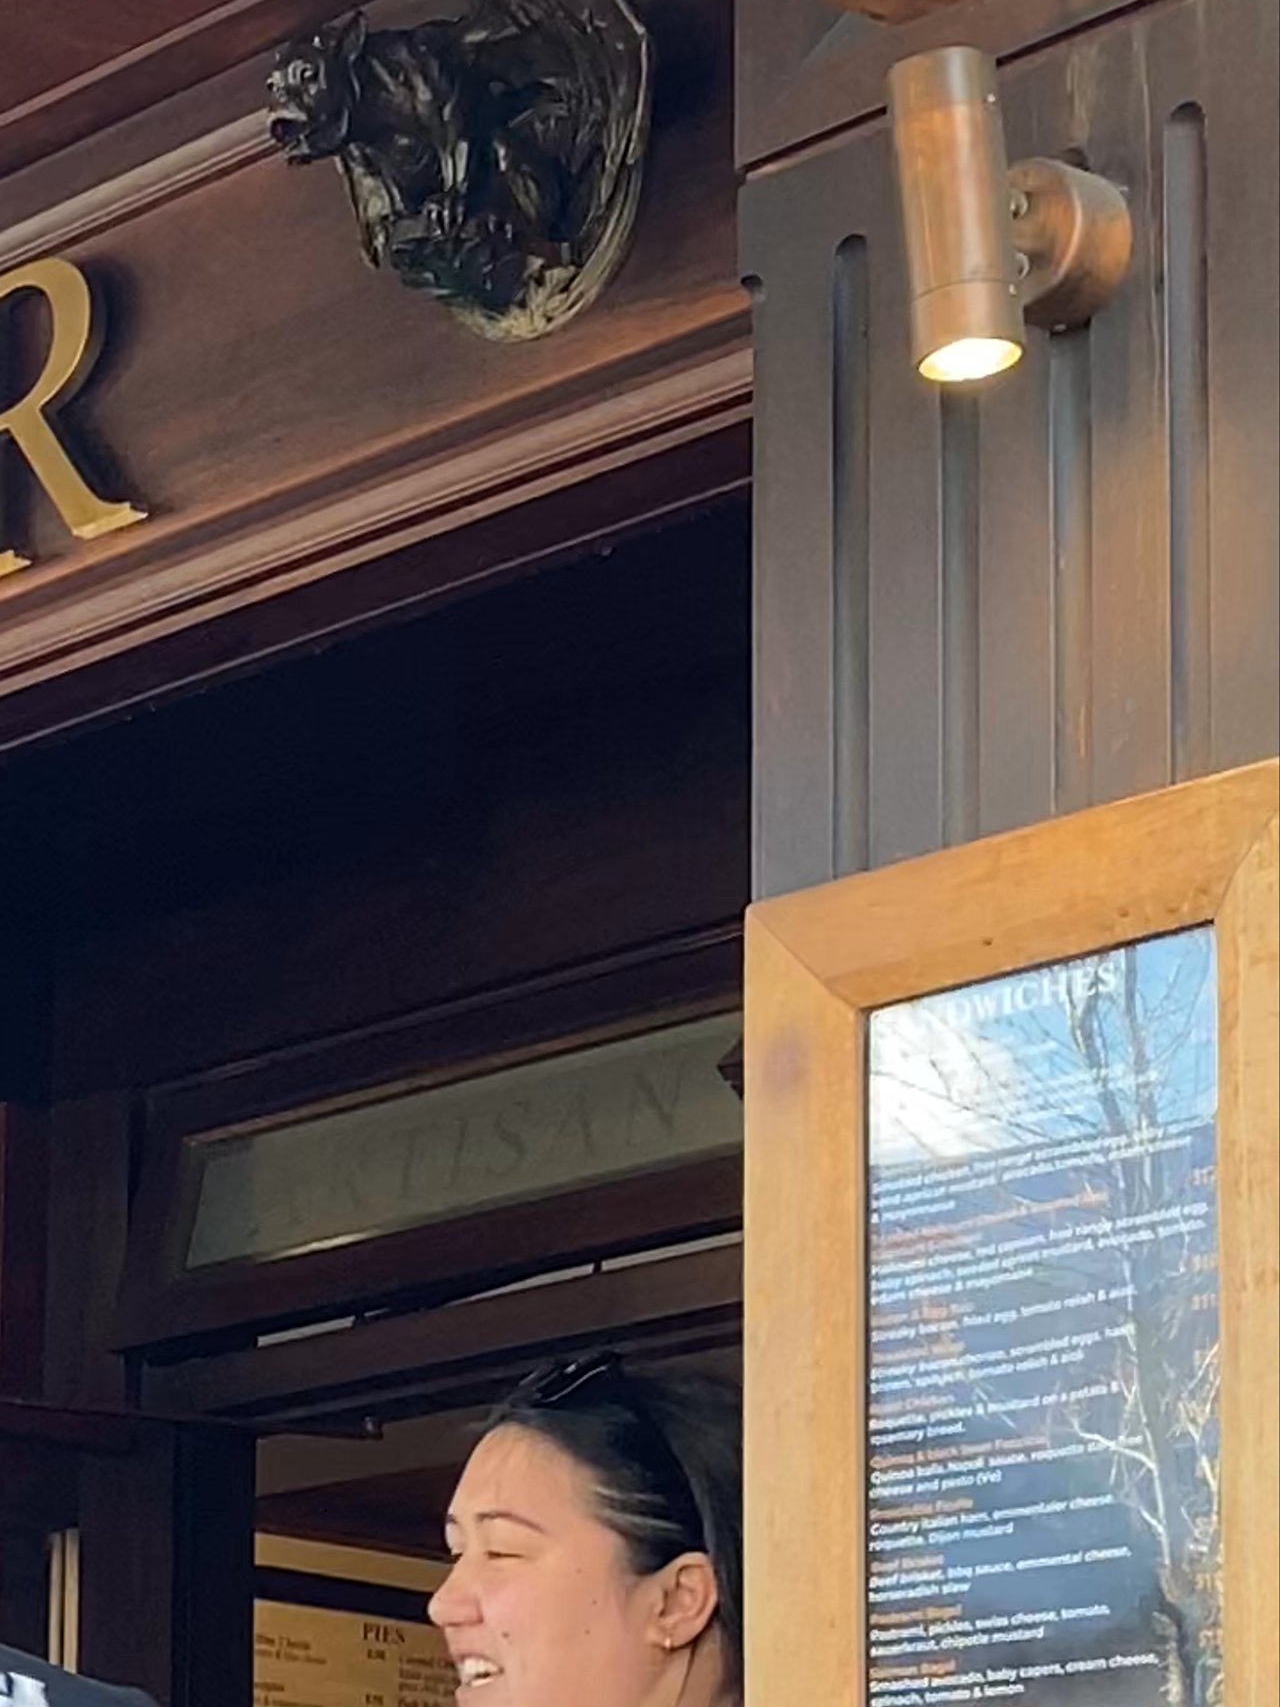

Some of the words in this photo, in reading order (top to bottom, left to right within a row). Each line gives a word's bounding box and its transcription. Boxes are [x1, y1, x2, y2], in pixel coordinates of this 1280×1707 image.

[363, 1623, 406, 1644] PIES
[1066, 1659, 1107, 1672] cream
[973, 1686, 982, 1697] &
